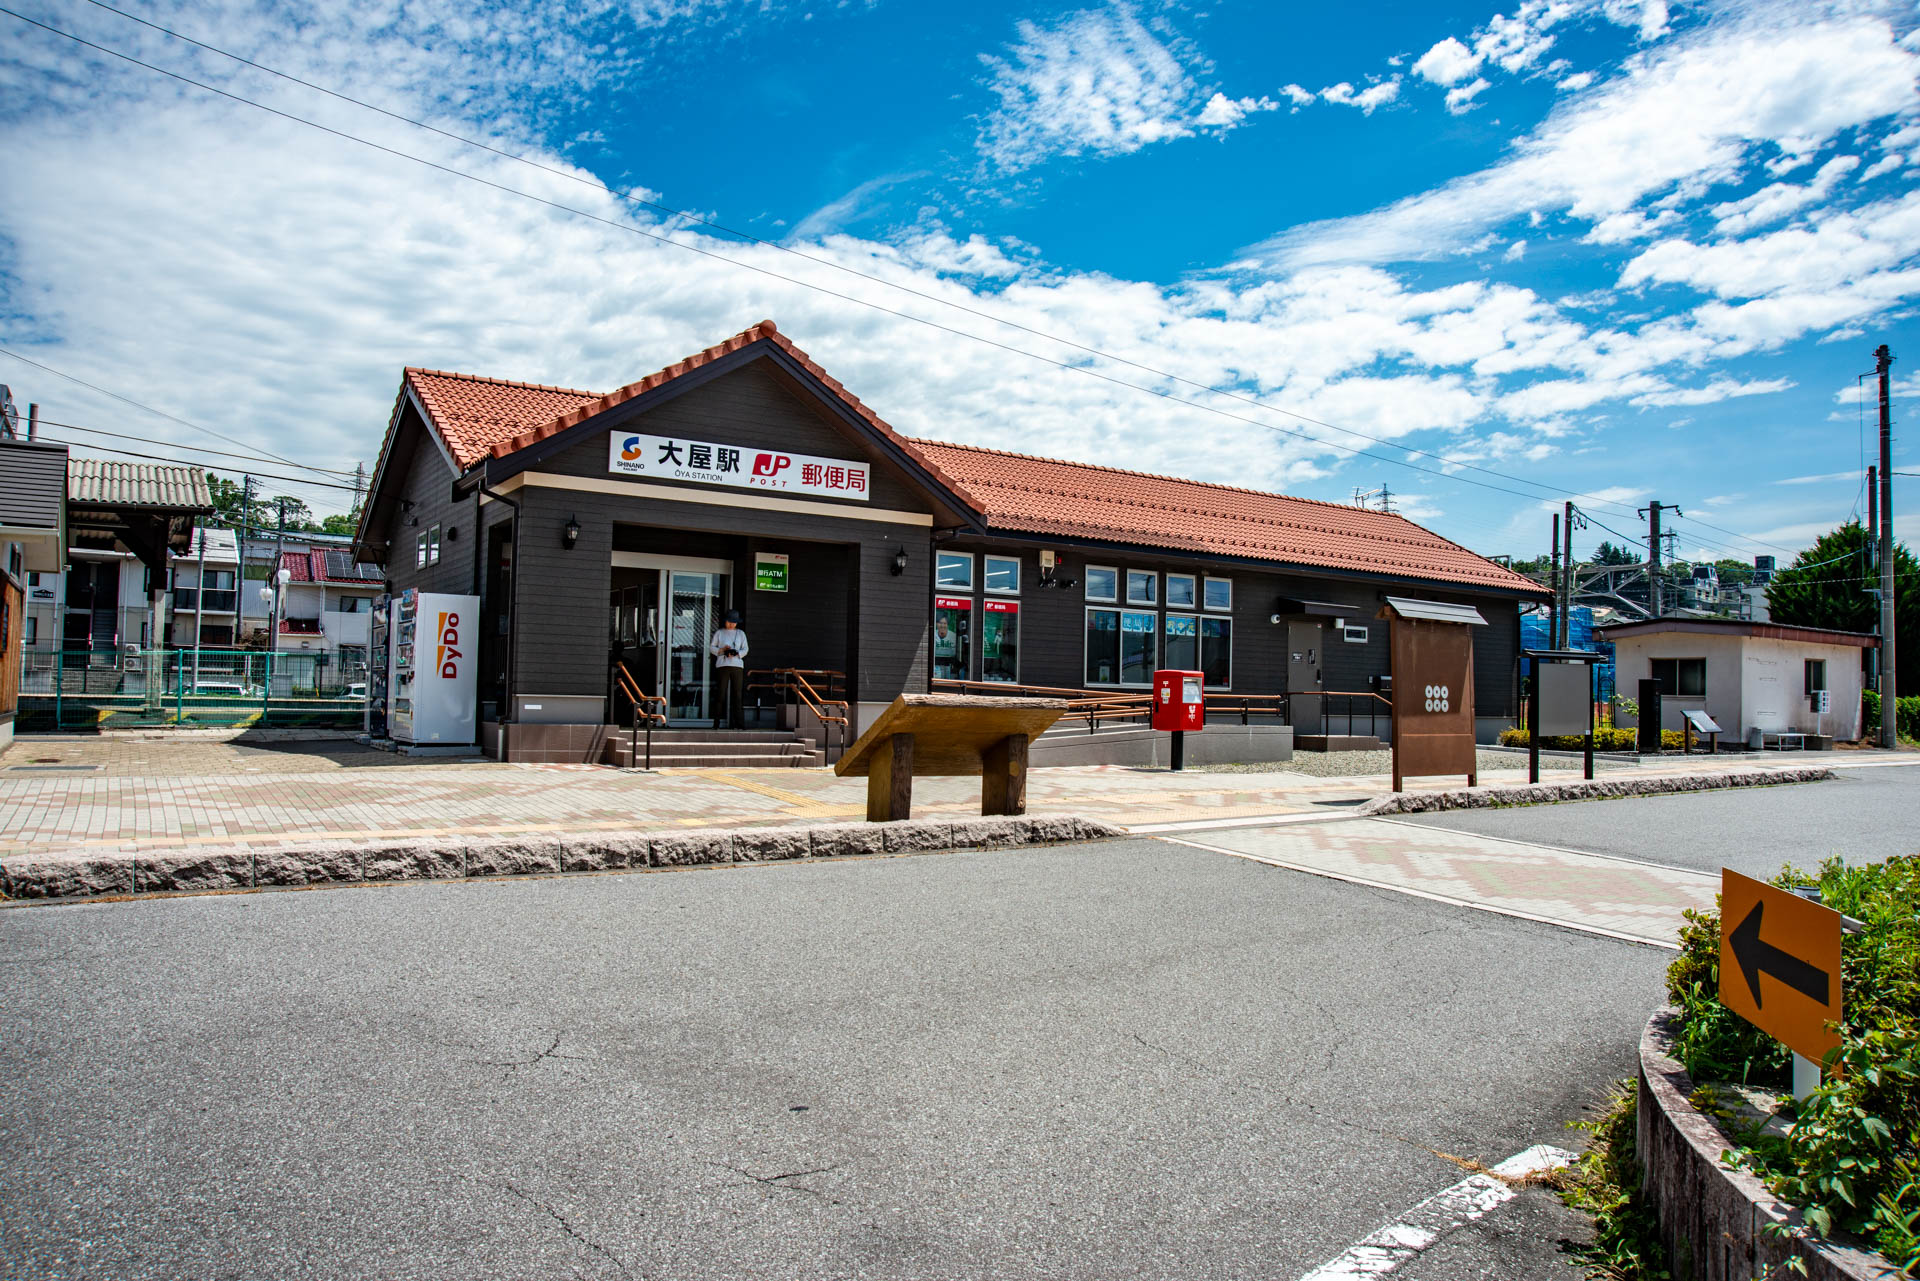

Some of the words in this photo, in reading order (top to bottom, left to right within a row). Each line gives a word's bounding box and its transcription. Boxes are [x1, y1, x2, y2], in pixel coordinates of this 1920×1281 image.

[617, 460, 645, 470] SHINANO
[658, 441, 739, 473] 大屋駅
[752, 453, 791, 476] JP
[691, 472, 723, 482] STATION
[750, 477, 787, 487] POST
[801, 463, 866, 492] 郵便局
[442, 612, 462, 679] DyDo
